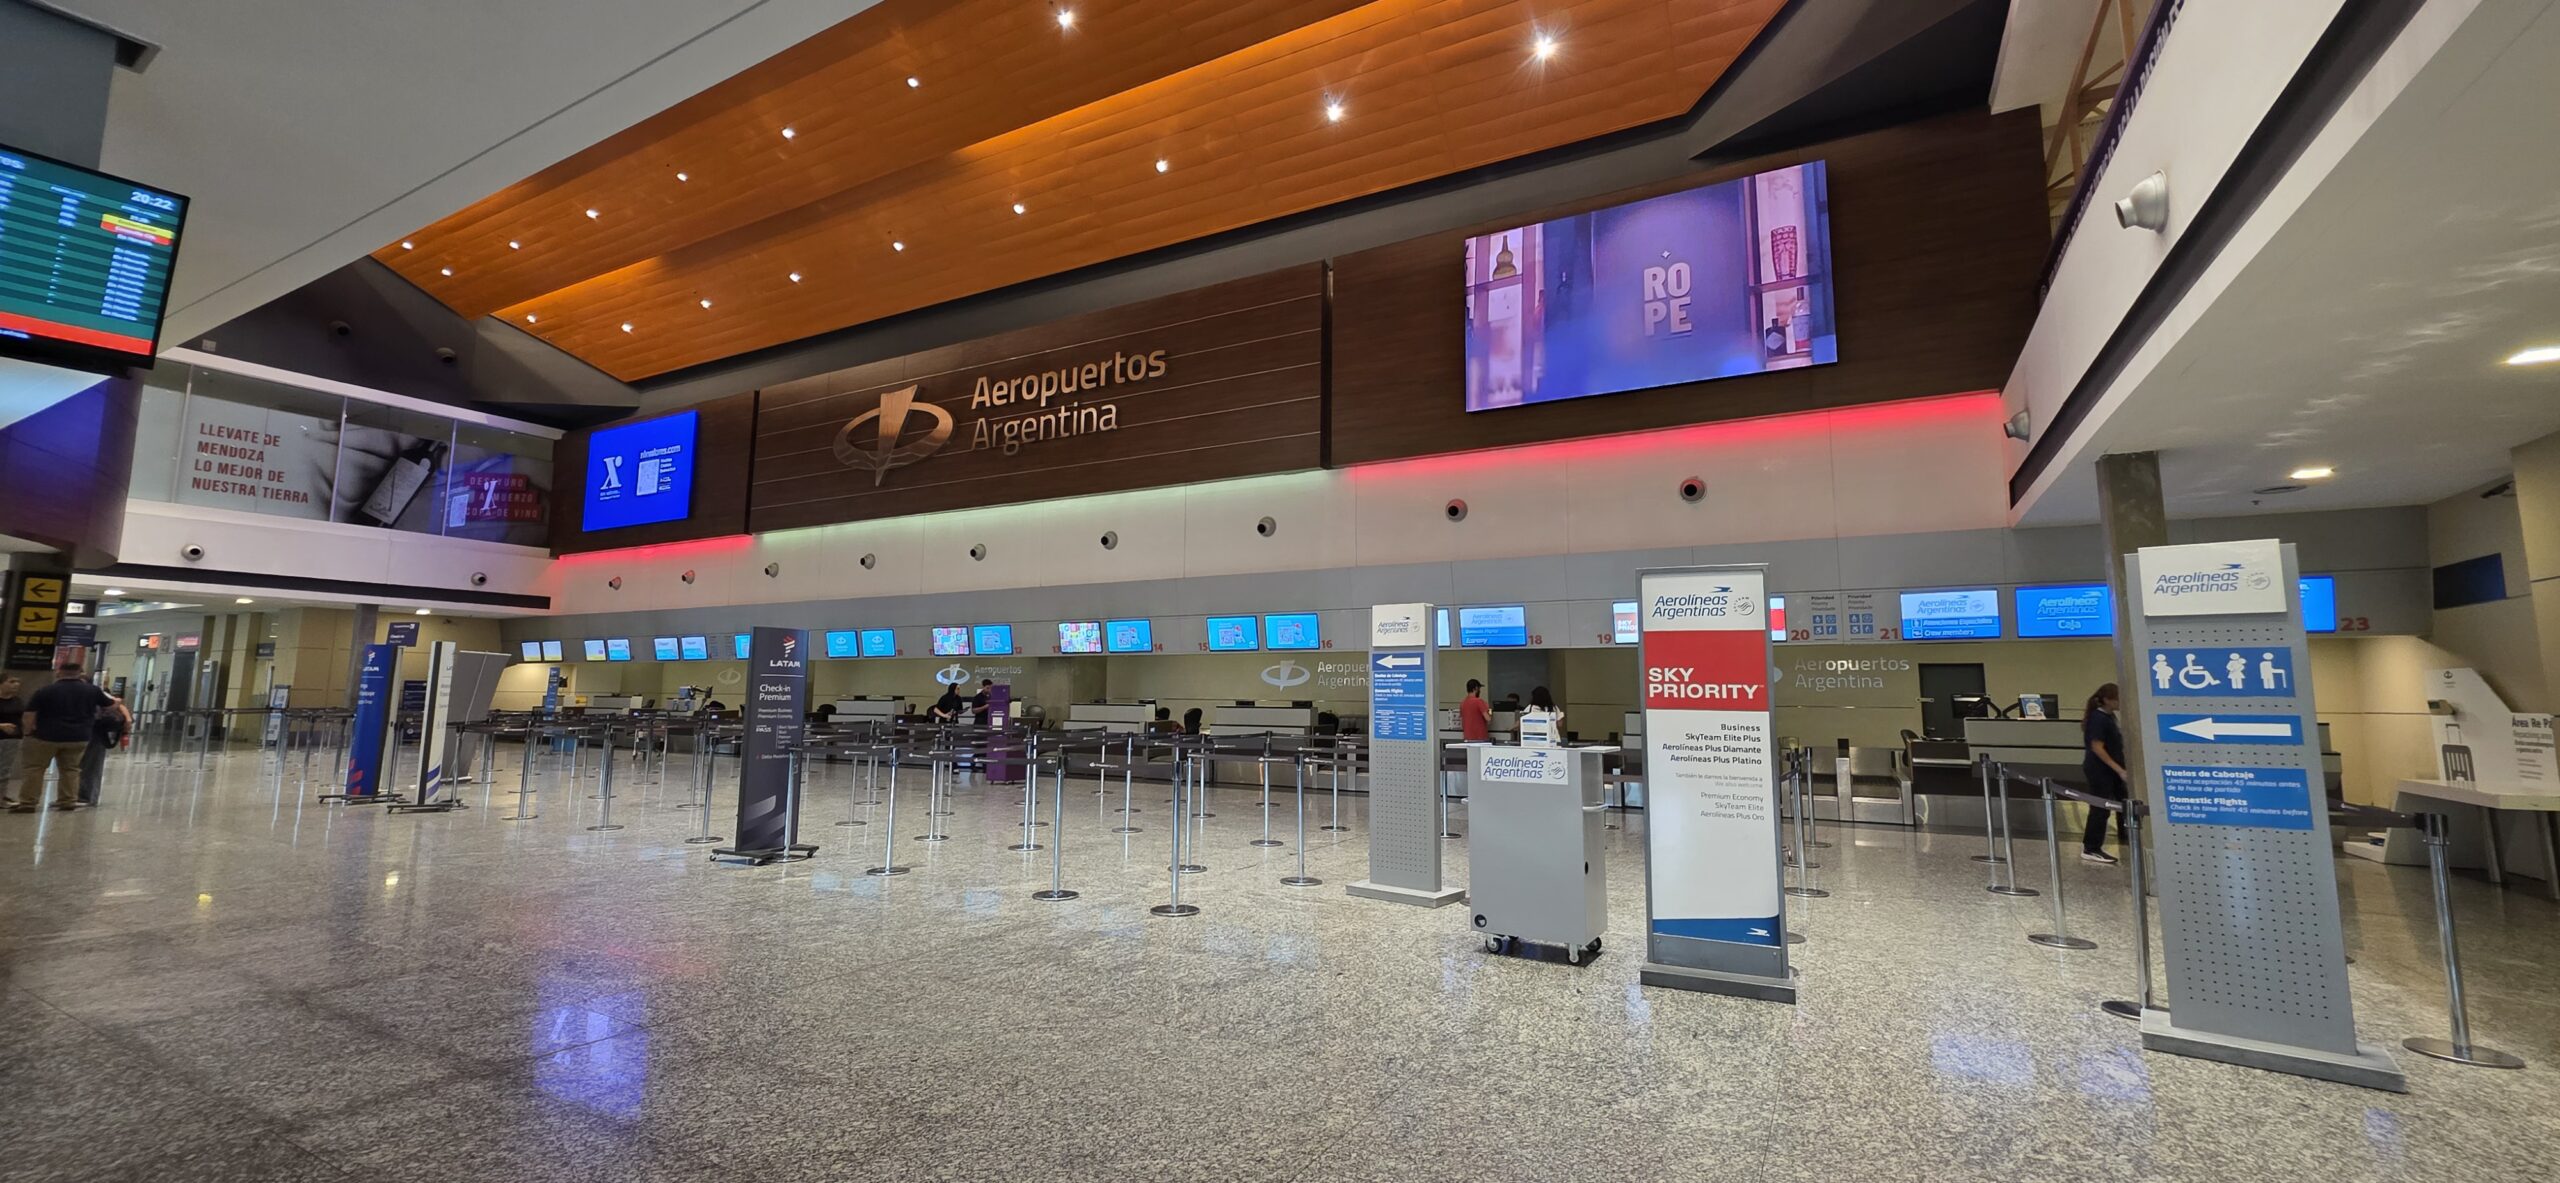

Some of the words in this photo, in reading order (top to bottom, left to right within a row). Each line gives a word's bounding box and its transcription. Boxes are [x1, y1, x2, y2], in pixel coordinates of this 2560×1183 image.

[131, 191, 174, 211] 20:22
[1644, 262, 1691, 301] RO
[1644, 296, 1693, 337] PE
[971, 350, 1166, 410] Aeropuertos
[200, 422, 259, 444] LLEVATE
[263, 433, 281, 447] DE
[971, 402, 1119, 456] Argentina
[197, 441, 265, 463] MENDOZA
[194, 459, 212, 473] LO
[217, 462, 263, 480] MEJOR
[268, 470, 285, 483] DE
[192, 477, 257, 497] NUESTRA
[262, 486, 309, 504] TIERRA
[2156, 571, 2239, 584] Aerolíneas
[2154, 582, 2238, 596] Argentinas
[1655, 594, 1728, 606] Aerolíneas
[1652, 606, 1727, 620] Argentinas
[2058, 620, 2082, 631] Caja
[2340, 617, 2370, 631] 23
[1528, 635, 1543, 645] 18
[1597, 634, 1612, 644] 19
[1790, 629, 1810, 641] 20
[1880, 628, 1899, 639] 21
[1198, 643, 1208, 651] 15
[1321, 639, 1333, 648] 16
[975, 664, 1022, 677] Aeropuertos
[1317, 661, 1369, 676] Aeropuer
[1795, 657, 1910, 675] Aeropuertos
[1648, 667, 1694, 682] SKY
[760, 684, 791, 692] Check-in
[1795, 674, 1884, 692] Argentina
[759, 693, 792, 701] Premium
[1649, 683, 1759, 699] PRIORITY
[1720, 723, 1761, 732] Business
[1685, 733, 1722, 742] SkyTeam
[1723, 734, 1742, 742] Elite
[1743, 734, 1761, 743] Plus
[1662, 743, 1703, 751] Aerolíneas
[1705, 744, 1722, 753] Plus
[1723, 745, 1762, 753] Diamante
[1485, 756, 1545, 769] Aerolíneas
[1670, 754, 1712, 763] Aerolíneas
[1713, 755, 1730, 764] Plus
[1732, 756, 1762, 765] Platino
[1483, 766, 1543, 779] Argentinas
[2164, 769, 2197, 777] Vuelos
[2198, 770, 2210, 778] de
[2212, 770, 2254, 779] Cabotaje
[1700, 792, 1731, 800] Premium
[1732, 794, 1764, 803] Economy
[2169, 796, 2212, 804] Domestic
[2214, 797, 2248, 807] Flights
[1714, 802, 1746, 810] SkyTeam
[1736, 812, 1751, 820] Plus
